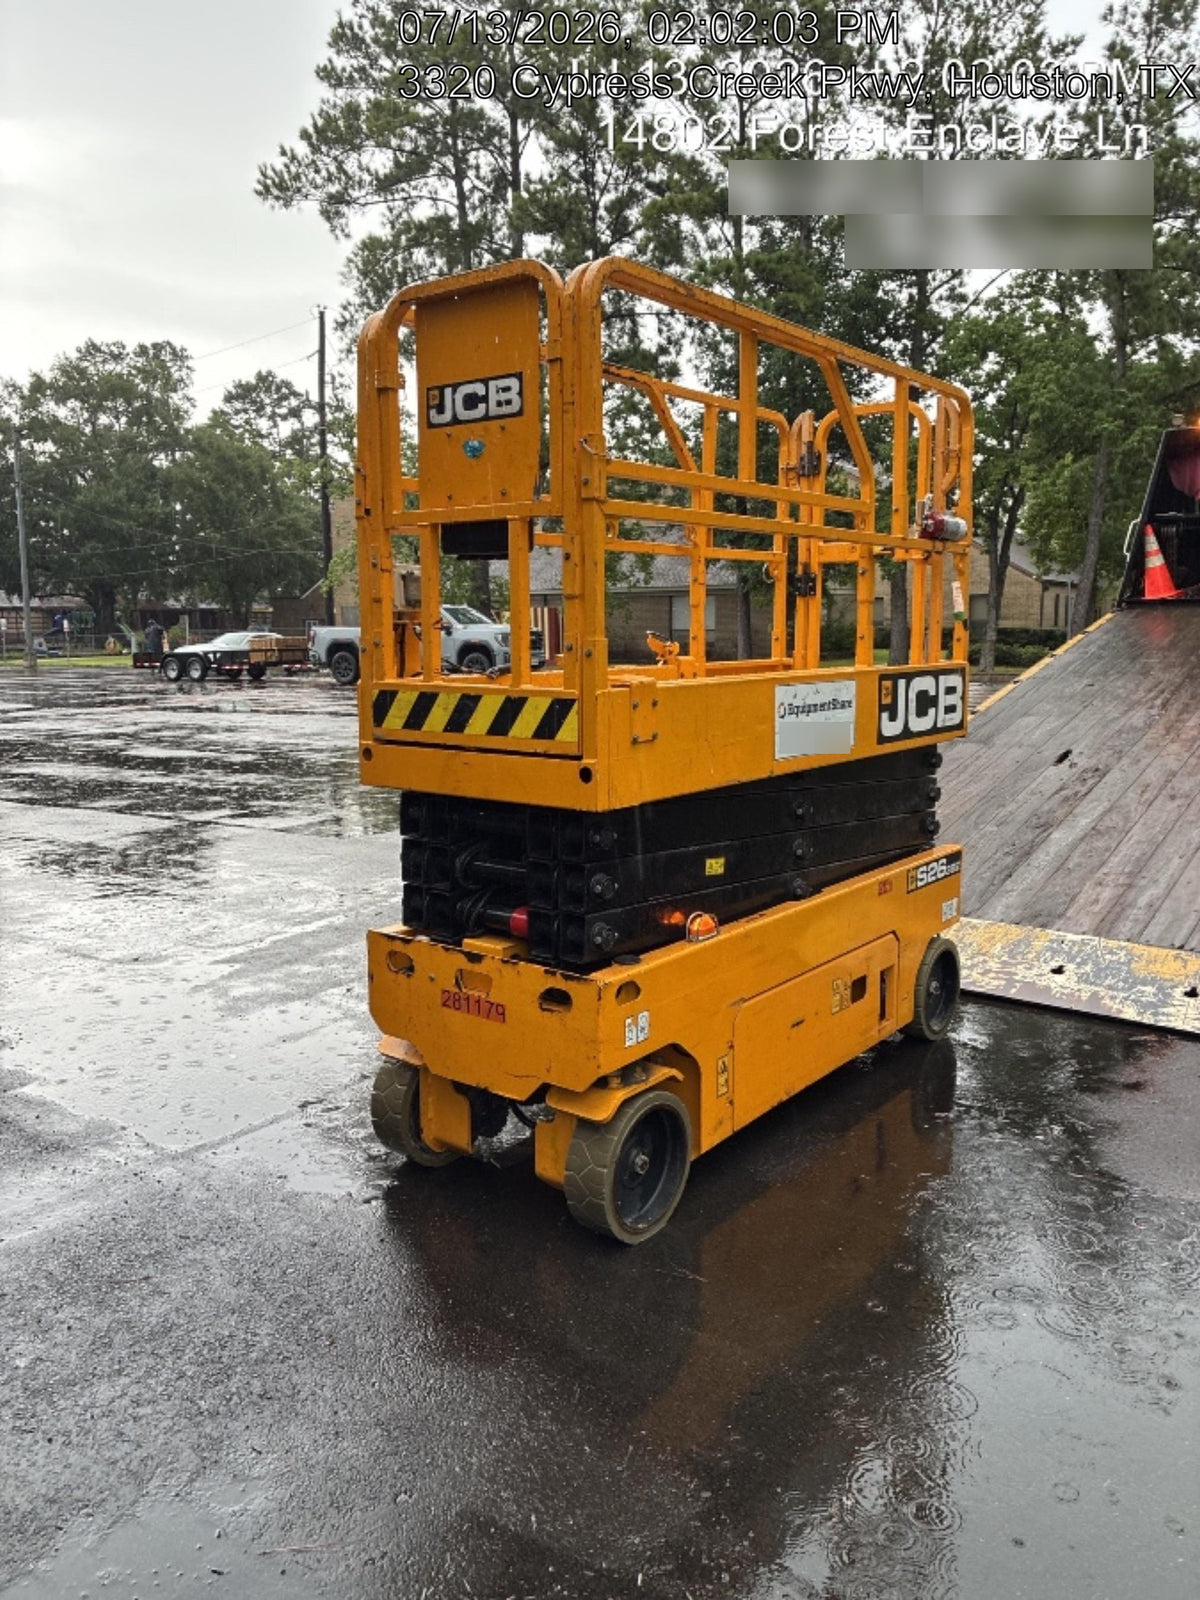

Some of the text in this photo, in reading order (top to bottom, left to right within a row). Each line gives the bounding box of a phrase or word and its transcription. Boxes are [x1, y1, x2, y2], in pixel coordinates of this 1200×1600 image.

[429, 376, 522, 424] JCB
[787, 698, 853, 718] EquipmentShare
[880, 674, 963, 737] JCB
[441, 989, 506, 1023] 281179
